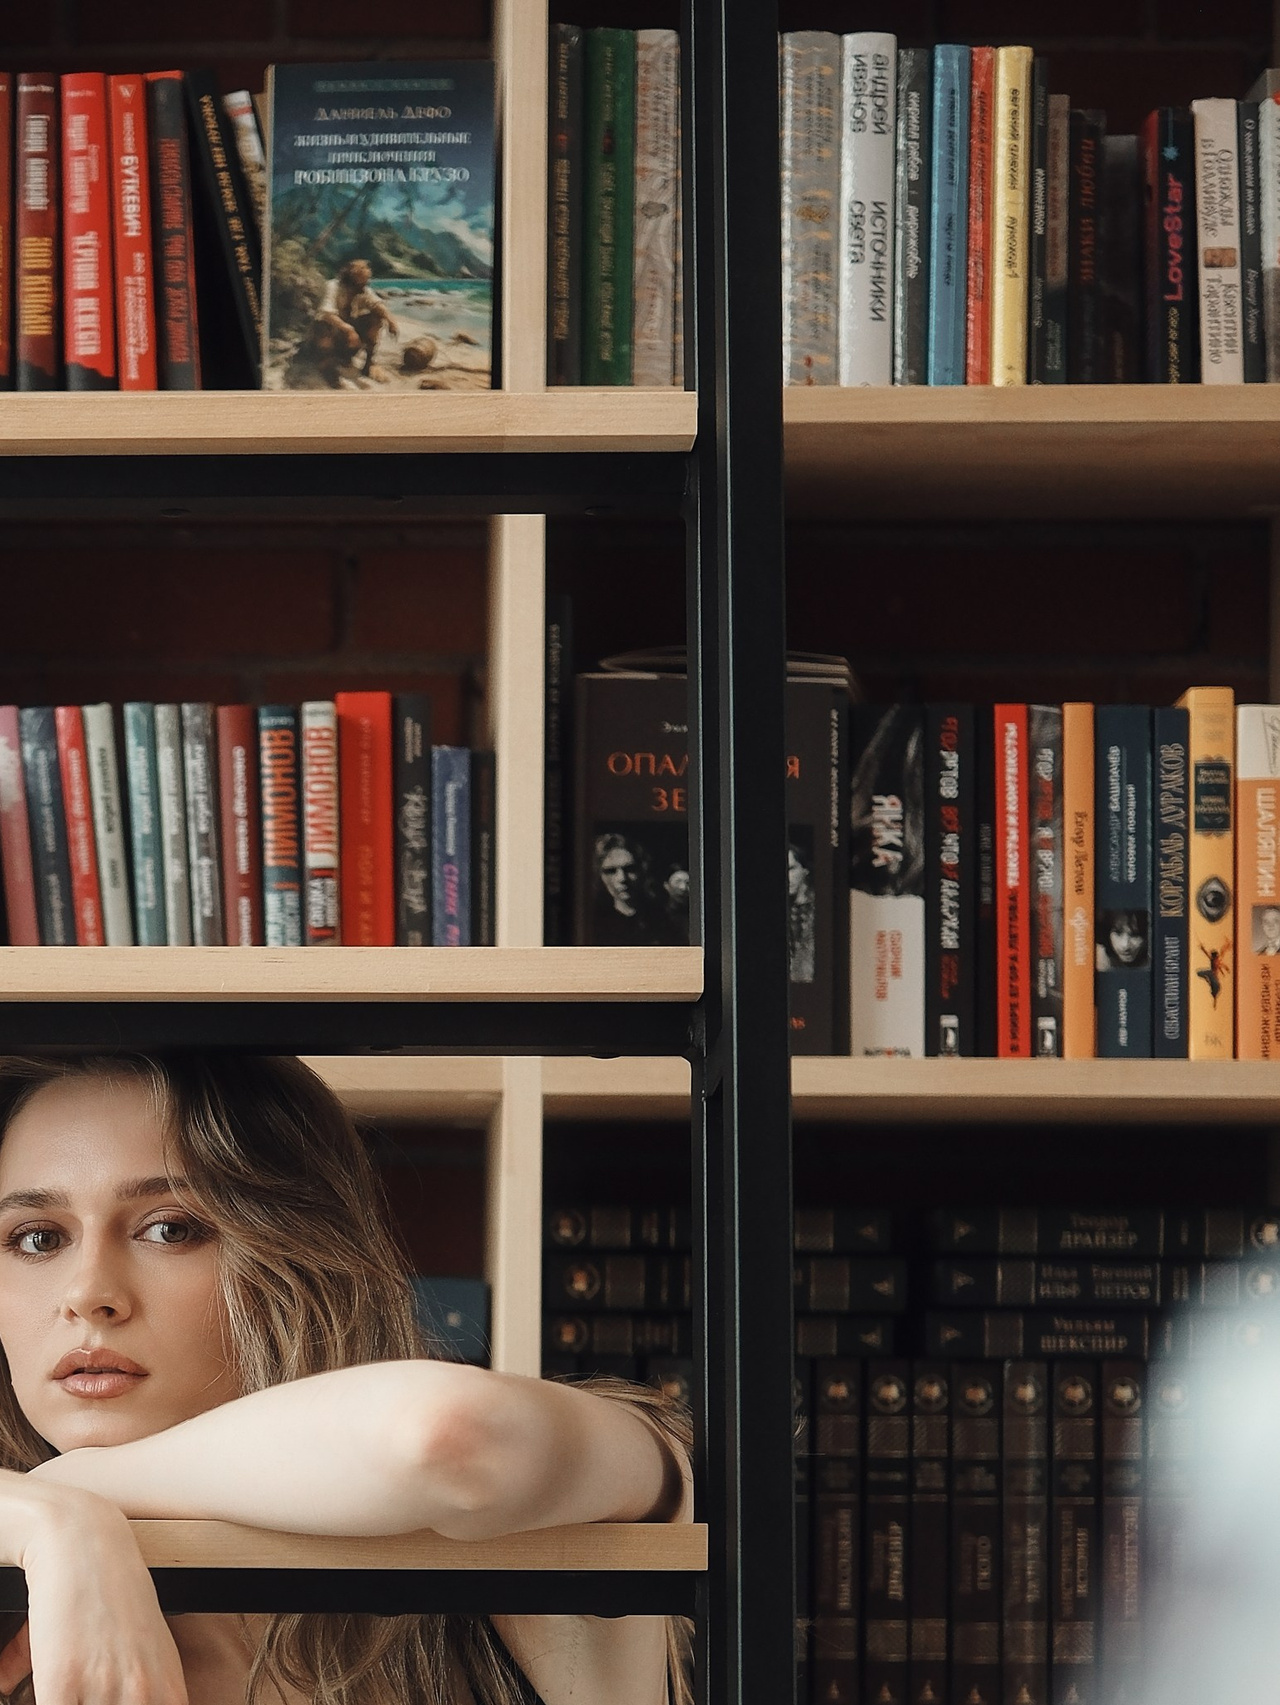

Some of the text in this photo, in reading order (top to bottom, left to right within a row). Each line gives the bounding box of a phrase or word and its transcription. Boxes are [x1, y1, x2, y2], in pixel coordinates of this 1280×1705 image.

[401, 104, 452, 120] ДЕФО
[906, 91, 922, 139] кирилл
[1007, 88, 1022, 142] евгений
[120, 155, 143, 237] БУТКЕВИЧ
[293, 167, 471, 185] РОБИНЗОНА КРУЗО
[1007, 145, 1021, 192] алехин
[1199, 149, 1219, 239] Голливуде
[906, 205, 923, 280] дирижабль
[1163, 172, 1184, 302] LoveStar
[1214, 149, 1239, 356] Однажды Квентин
[1203, 274, 1223, 365] Тарантино
[259, 729, 299, 868] ЛИМОНОВ
[303, 726, 336, 856] ЛИМОНОВ
[1004, 722, 1019, 812] КОНТЕКСТЫ
[1159, 742, 1187, 830] ДУРАКОВ
[232, 745, 250, 875] александр пелевин
[871, 794, 904, 869] ЯНКА
[1256, 787, 1277, 898] ШАЛЯПИН
[1006, 829, 1020, 889] ТЕКСТЫ
[1160, 833, 1186, 918] КОРАБЛЬ
[1060, 1230, 1138, 1249] ДРАЙЗЕР
[1040, 1334, 1128, 1353] ШЕКСПИР
